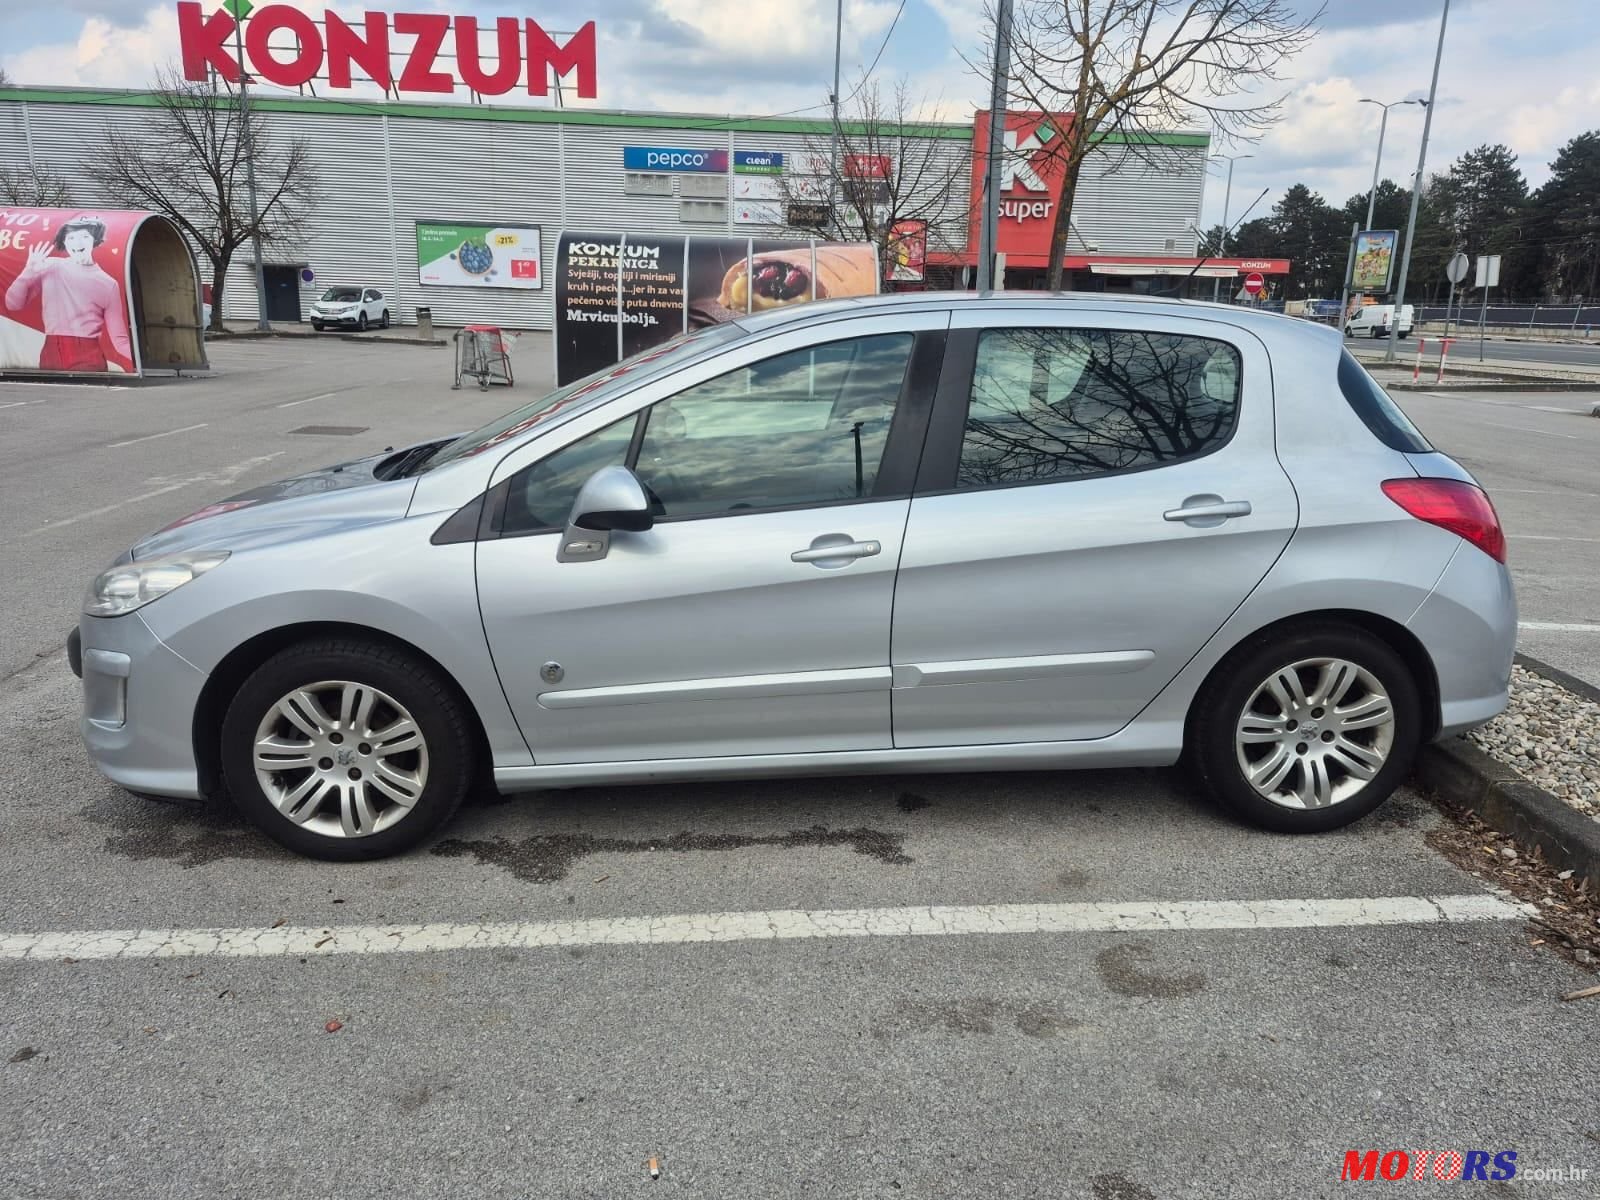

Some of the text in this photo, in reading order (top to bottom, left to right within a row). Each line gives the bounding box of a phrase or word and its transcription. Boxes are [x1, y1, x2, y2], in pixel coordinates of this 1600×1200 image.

[177, 1, 597, 98] KONZUM
[647, 152, 704, 167] pepco
[998, 200, 1053, 223] super
[0, 229, 30, 249] BE
[568, 242, 660, 258] KONZUM
[568, 256, 659, 269] PEKARNICA
[640, 272, 676, 284] mirisniji
[567, 281, 589, 291] kruh
[647, 285, 656, 294] ih
[567, 296, 604, 307] pečemo
[626, 299, 648, 309] puta
[649, 298, 684, 309] dnevno
[621, 311, 660, 327] bolja.
